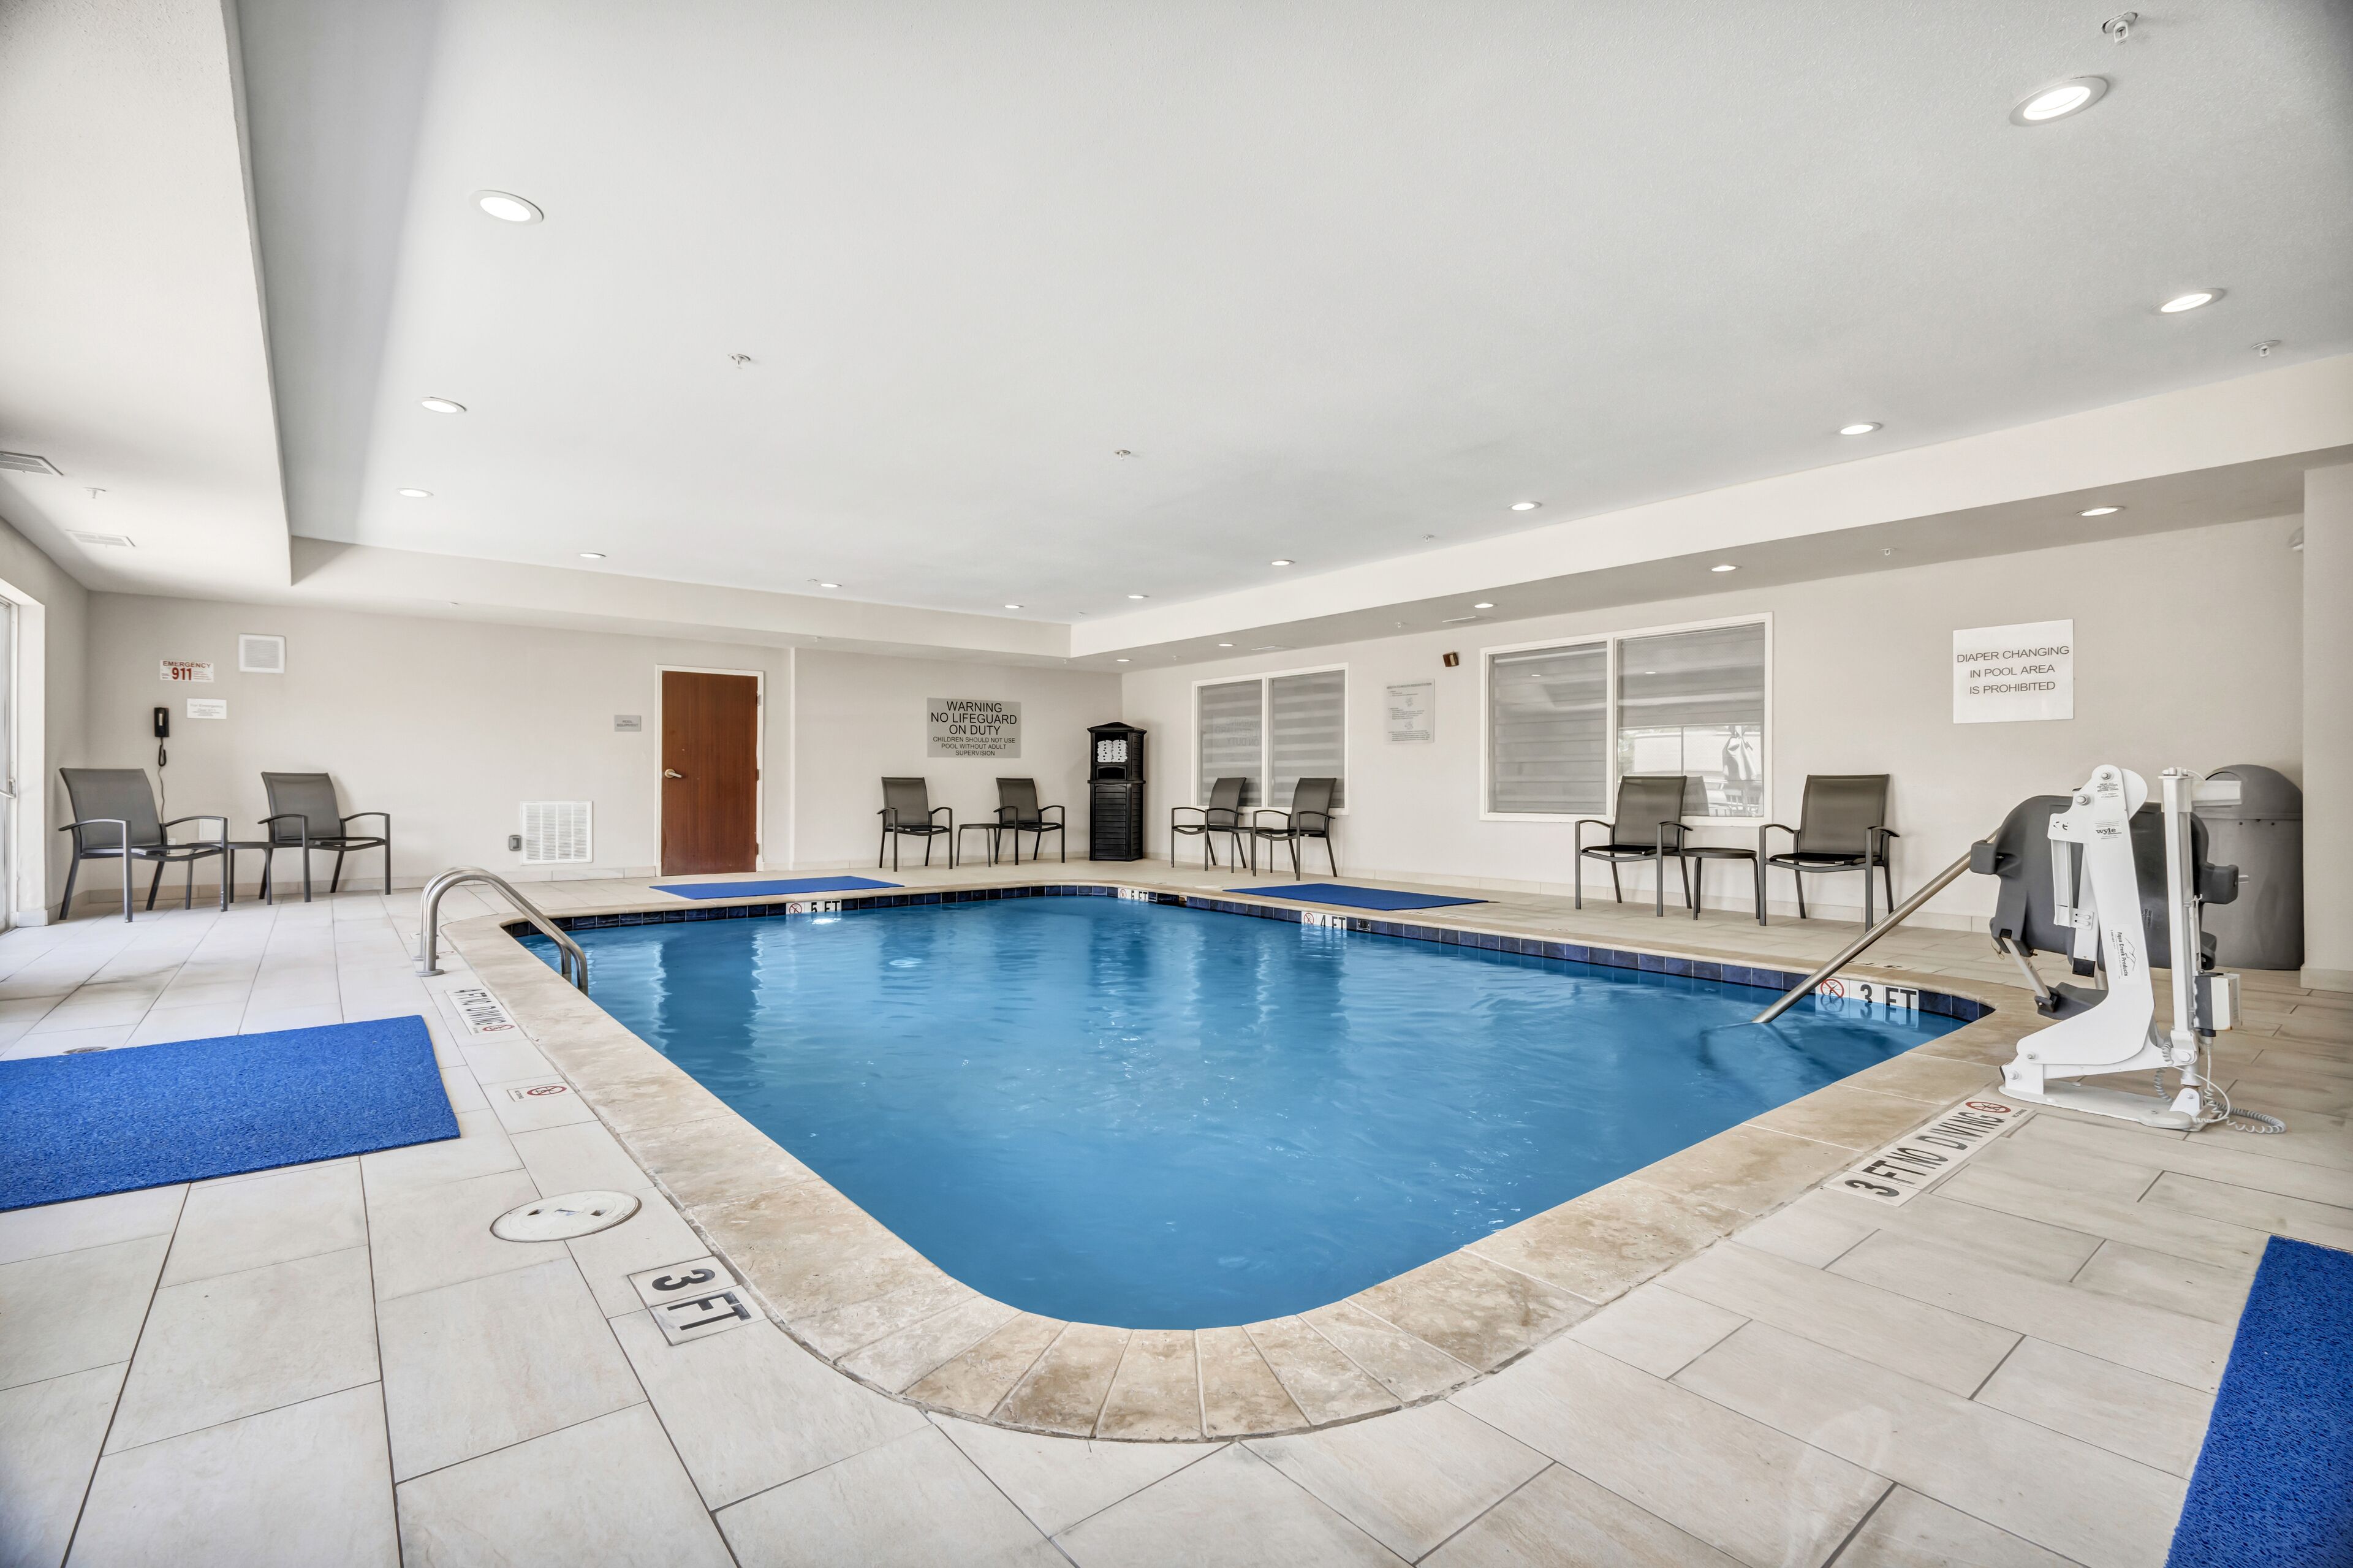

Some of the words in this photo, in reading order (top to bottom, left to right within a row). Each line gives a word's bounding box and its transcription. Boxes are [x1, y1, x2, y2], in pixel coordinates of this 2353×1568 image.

[1957, 651, 1999, 663] DIAPER
[2003, 646, 2069, 659] CHANGING
[172, 667, 192, 681] 911
[1970, 670, 1980, 678] IN
[1984, 667, 2017, 677] POOL
[2020, 664, 2055, 675] AREA
[1969, 686, 1980, 695] IS
[1983, 681, 2056, 694] PROHIBITED
[947, 701, 1002, 713] WARNING
[931, 712, 949, 723] NO
[952, 713, 1017, 724] LIFEGUARD
[949, 724, 966, 735] ON
[970, 725, 1001, 735] DUTY
[1139, 891, 1148, 901] FT
[811, 901, 817, 912] 5
[824, 900, 841, 912] FT
[1332, 915, 1346, 930] FT
[1860, 983, 1873, 1003] 3
[1885, 986, 1917, 1009] FT
[465, 1006, 507, 1025] DIVING
[1915, 1112, 2006, 1151] DIVING
[1885, 1147, 1949, 1170] NO
[1862, 1159, 1928, 1185] FT
[1844, 1179, 1900, 1197] 3
[651, 1268, 716, 1291] 3
[667, 1290, 751, 1331] FT
